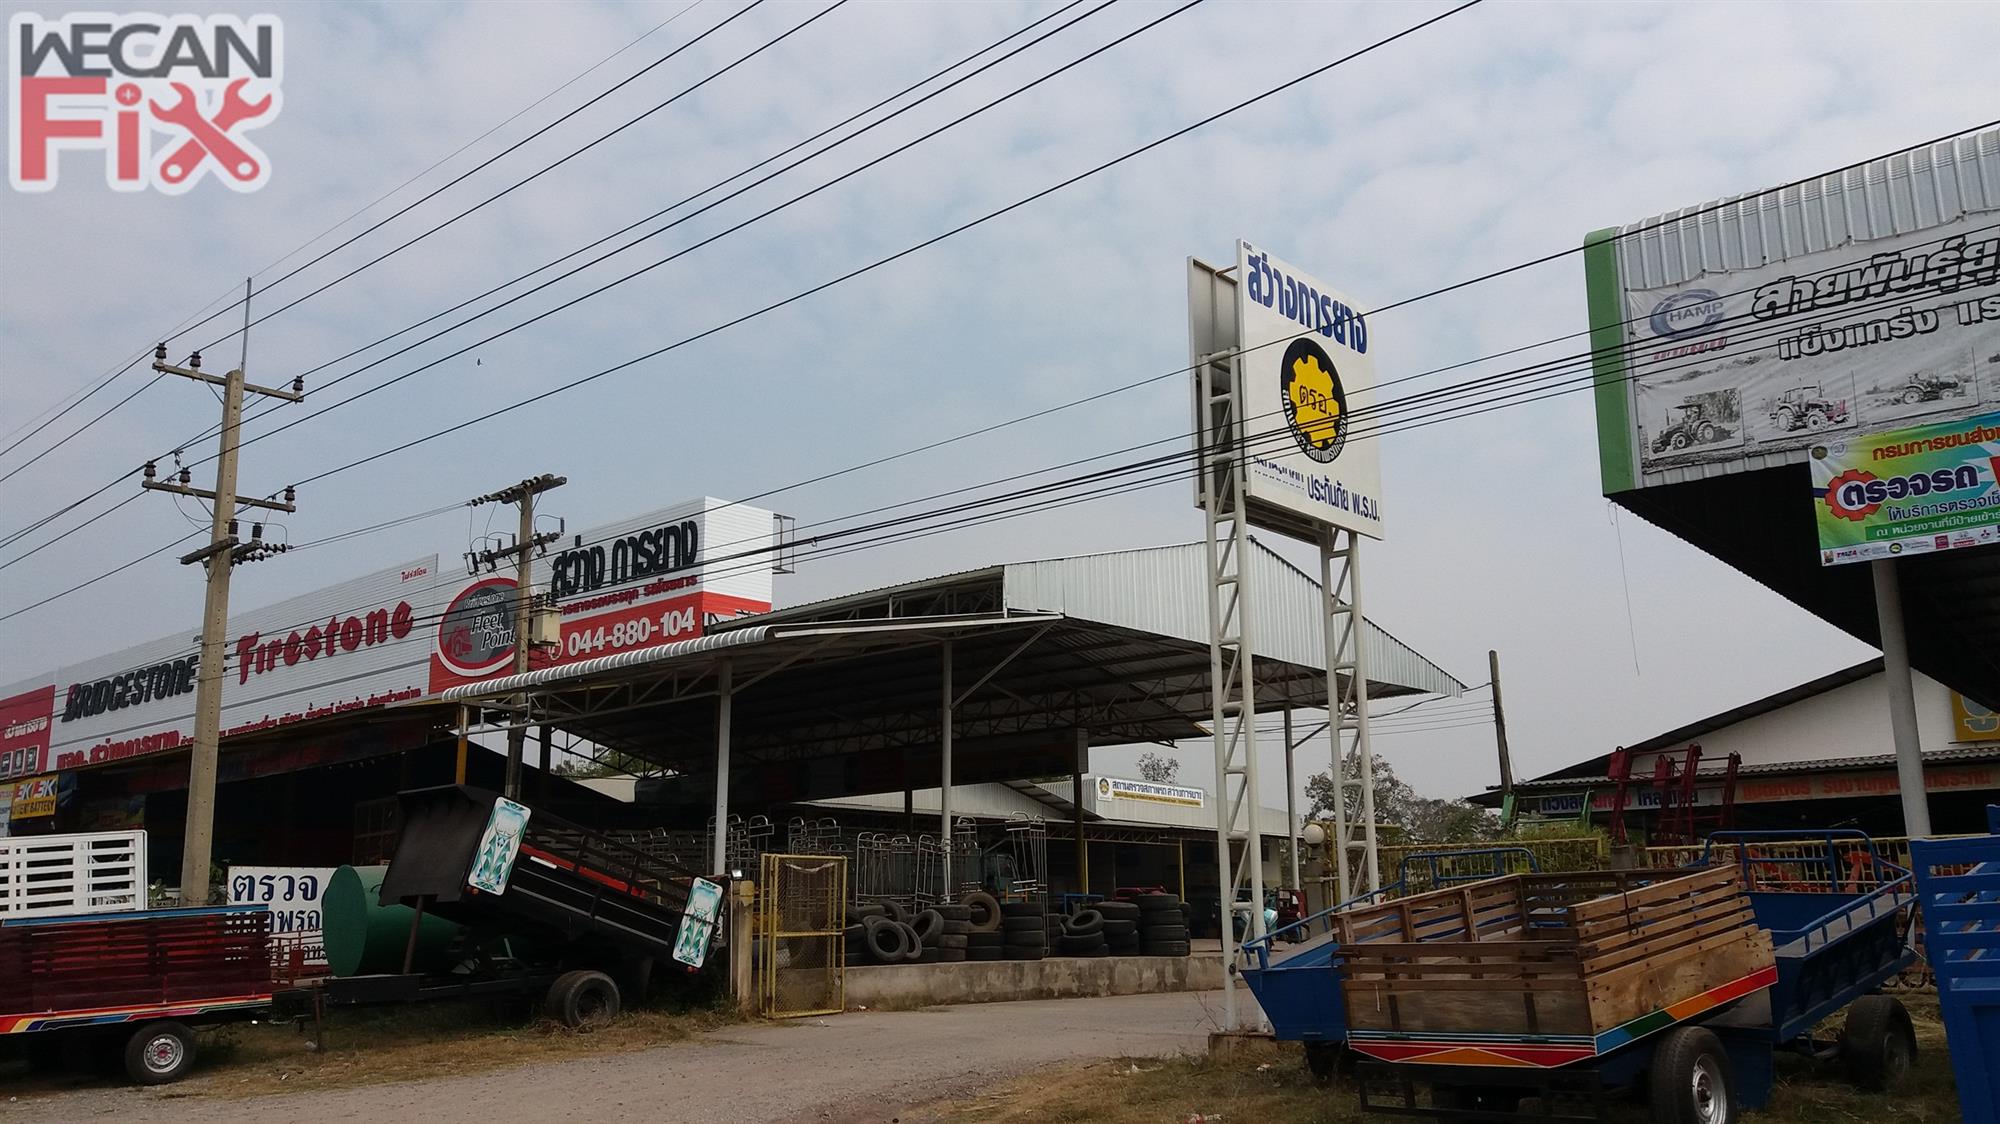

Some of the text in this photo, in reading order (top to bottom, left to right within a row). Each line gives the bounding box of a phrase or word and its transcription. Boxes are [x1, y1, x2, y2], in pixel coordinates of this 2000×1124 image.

[1752, 235, 2000, 320] สายพันธุ์ยุ
[1247, 252, 1367, 355] สว่างการยาง
[1778, 306, 1939, 360] แข็งแกร่ง
[1957, 294, 2000, 326] แร
[1872, 425, 2000, 461] กรมการขนส่ง
[1307, 474, 1380, 522] ประกันภัย พ.ร.บ.
[1842, 464, 1980, 507] ตรวจรถ
[1886, 489, 2000, 521] ให้บริการตรวจเช็
[551, 520, 699, 599] สว่าง การยาง
[236, 600, 413, 686] Firestone
[470, 609, 504, 635] Fleet
[481, 625, 516, 651] Point
[568, 606, 695, 657] 044-880-104
[61, 655, 199, 723] BRIDGESTONE
[37, 780, 56, 798] 3K
[232, 874, 318, 902] ตรวจ
